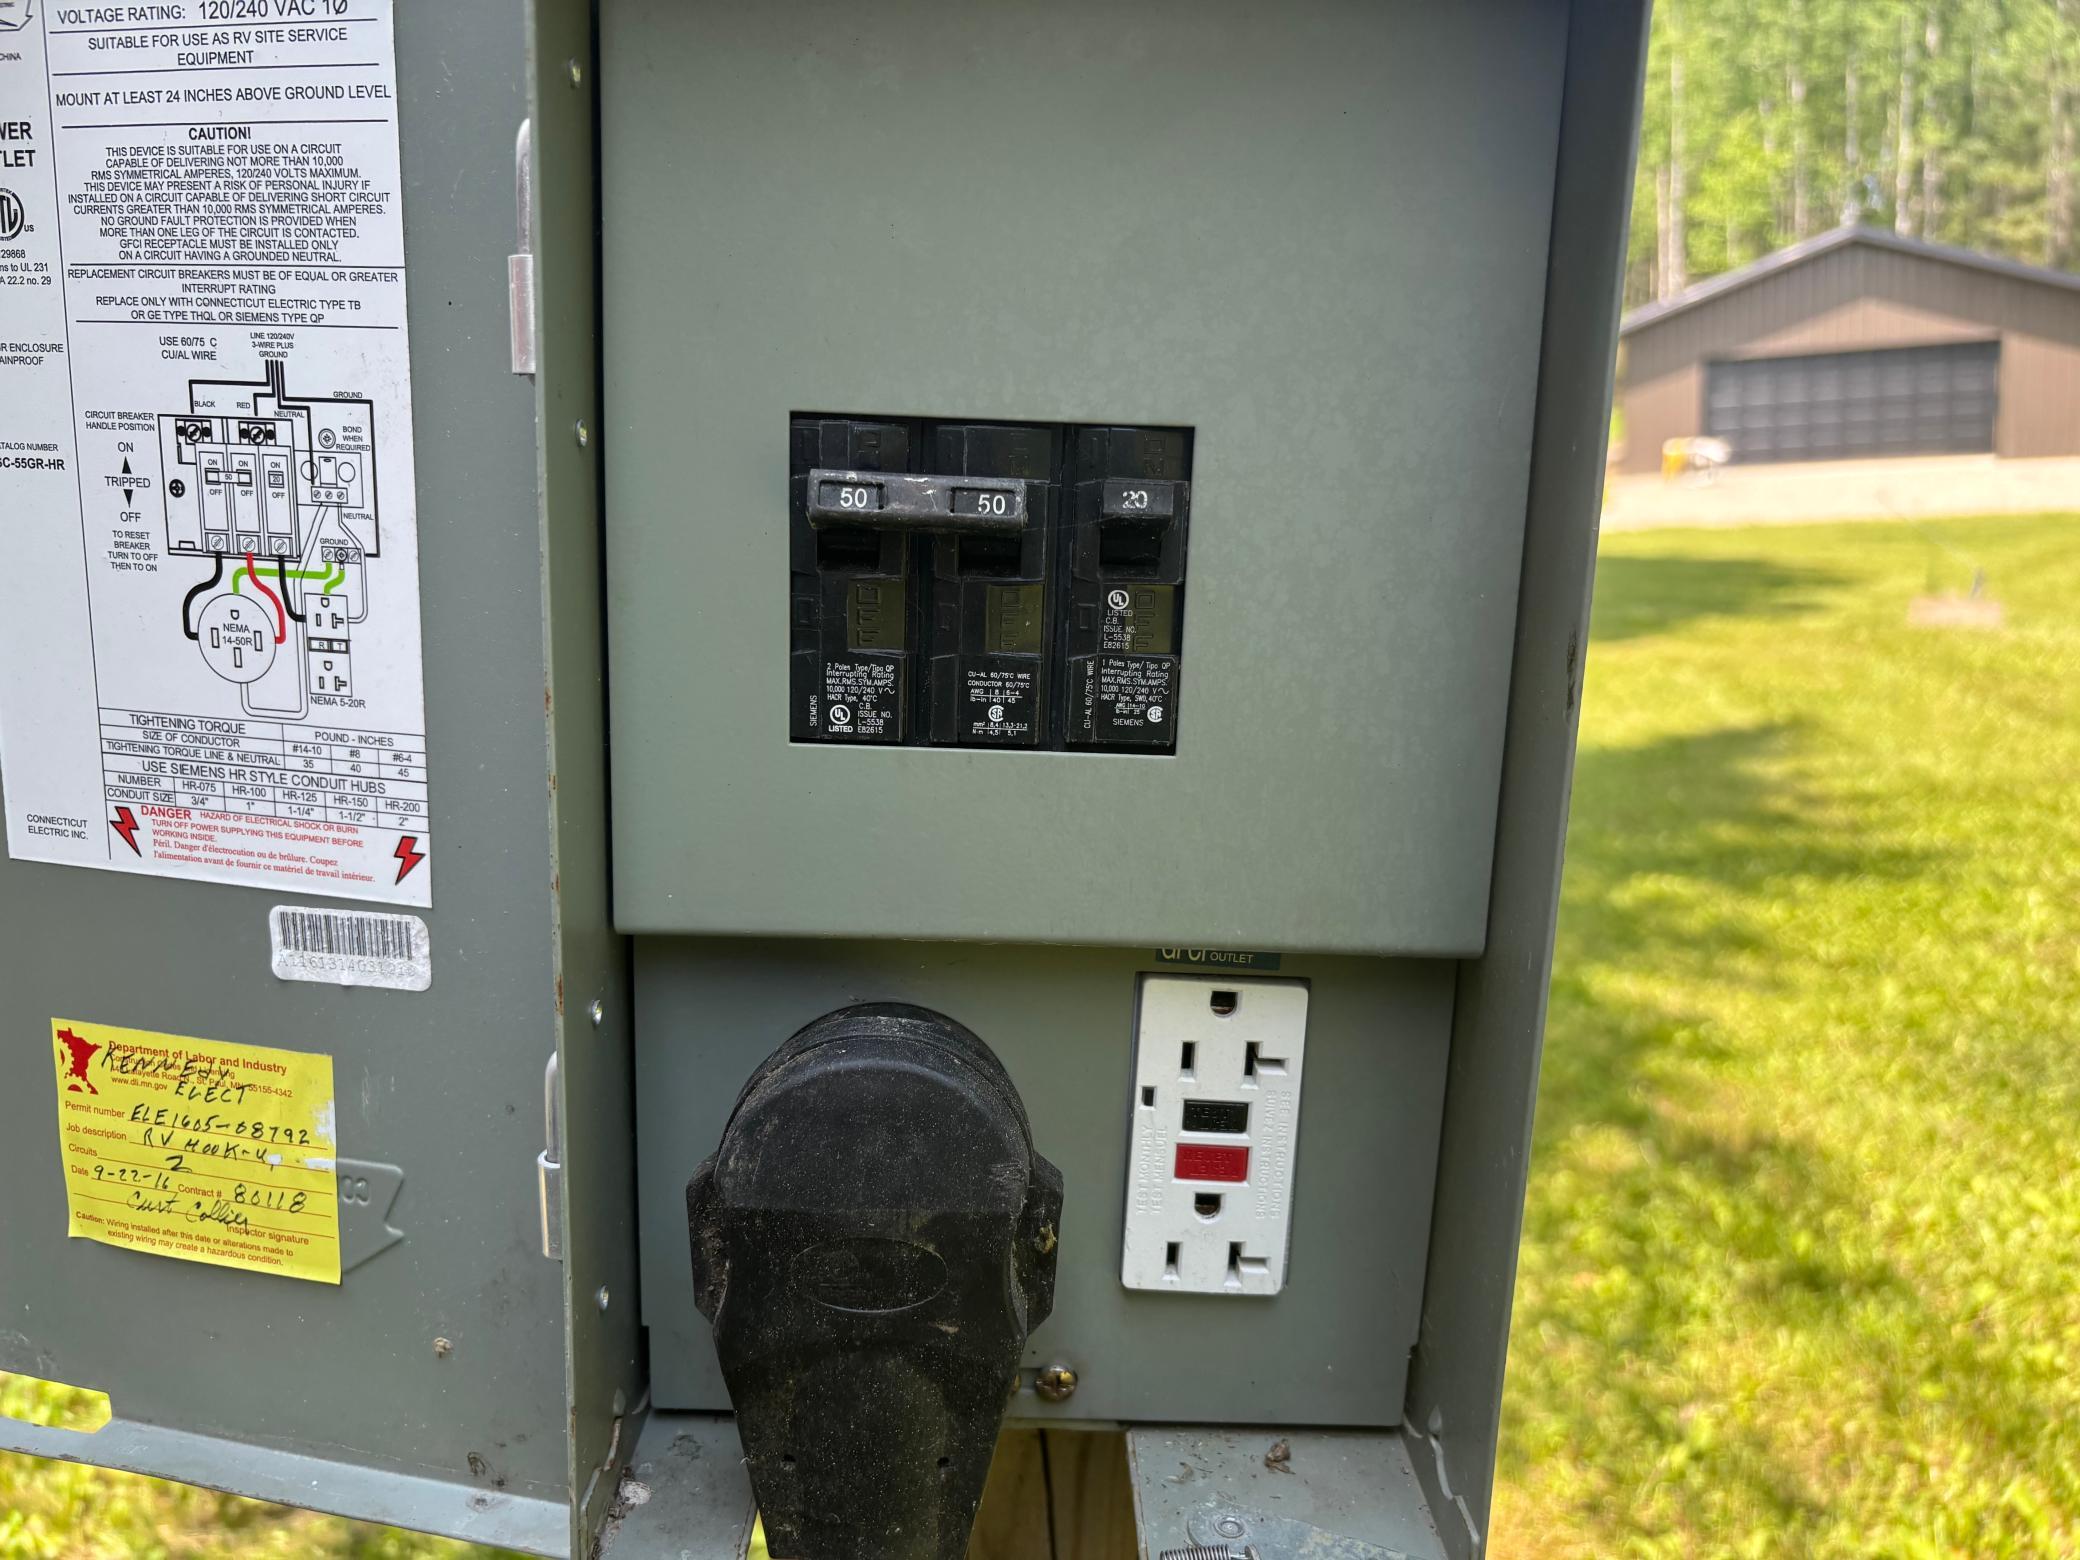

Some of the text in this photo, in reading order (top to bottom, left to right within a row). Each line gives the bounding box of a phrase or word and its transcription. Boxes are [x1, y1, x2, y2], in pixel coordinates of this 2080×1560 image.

[57, 8, 124, 24] VOLTAGE
[128, 5, 186, 20] RATING:
[199, 0, 268, 19] 120/240
[274, 0, 315, 16] VAC
[87, 26, 348, 50] SUITABLE FOR USE AS RV SITE SERVICE
[177, 51, 254, 66] EQUIPMENT
[55, 84, 392, 106] MOUNT AT LEAST 24 INCHES ABOVE GROUND LEVEL
[188, 126, 251, 140] CAUTION!
[104, 143, 342, 158] THIS DEVICE IS SUITABLE FOR USE ON A CIRCUIT
[105, 155, 344, 168] CAPABLE OF DELIVERING NOT MORE THAN 10,000
[24, 224, 34, 232] US
[11, 262, 48, 272] to UL 231
[7, 275, 51, 285] 22.2 no. 29
[95, 295, 361, 310] REPLACE ONLY WITH CONNECTICUT ELECTRIC TYPE TB
[131, 311, 324, 323] OR GE TYPE THQL OR SIEMENS TYPE QP
[10, 343, 64, 353] ENCLOSURE
[158, 335, 217, 348] USE 60/75 C
[160, 349, 217, 360] CU/AL WIRE
[333, 391, 363, 399] GROUND
[194, 400, 216, 408] BLACK
[85, 411, 154, 420] CIRCUIT BREAKER
[273, 410, 305, 418] NEUTRAL
[86, 421, 155, 431] HANDLE POSITION
[117, 441, 134, 453] ON
[105, 476, 151, 488] TRIPPED
[840, 488, 1006, 515] 50 50
[1122, 490, 1148, 510] 20
[120, 511, 141, 522] OFF
[1107, 609, 1133, 617] LISTED
[223, 623, 250, 634] NEMA
[222, 636, 253, 646] 14-50R
[1101, 668, 1168, 679] Interrupting Rating
[310, 696, 366, 708] NEMA 5-20R
[809, 695, 818, 727] SIEMENS
[857, 710, 877, 718] ISSUE
[130, 714, 246, 734] TIGHTENING TORQUE
[1113, 718, 1144, 726] SIEMENS
[828, 725, 853, 733] LISTED
[143, 730, 240, 747] SIZE OF CONDUCTOR
[314, 730, 350, 743] POUND
[357, 734, 394, 747] INCHES
[118, 774, 161, 787] NUMBER
[142, 760, 386, 794] USE SIEMENS HR STYLE CONDUIT HUBS
[182, 780, 216, 792] HR-075
[232, 785, 266, 797] HR-100
[107, 787, 175, 803] CONDUIT SIZE
[282, 790, 317, 802] HR-125
[333, 795, 368, 807] HR-150
[141, 805, 192, 820] DANGER
[385, 801, 420, 813] HR-200
[27, 813, 88, 828] CONNECTICUT
[28, 826, 89, 840] ELECTRIC INC.
[1209, 952, 1254, 964] OUTLET
[172, 1050, 183, 1060] of
[186, 1051, 216, 1064] Labor
[220, 1055, 239, 1067] and
[243, 1058, 287, 1076] Industry
[65, 1100, 125, 1118] Permit number
[66, 1122, 127, 1140] Job description
[69, 1143, 98, 1157] Circuits
[71, 1164, 89, 1177] Date
[165, 1155, 193, 1173] 2
[178, 1184, 222, 1198] Contract #
[268, 1232, 310, 1245] signature
